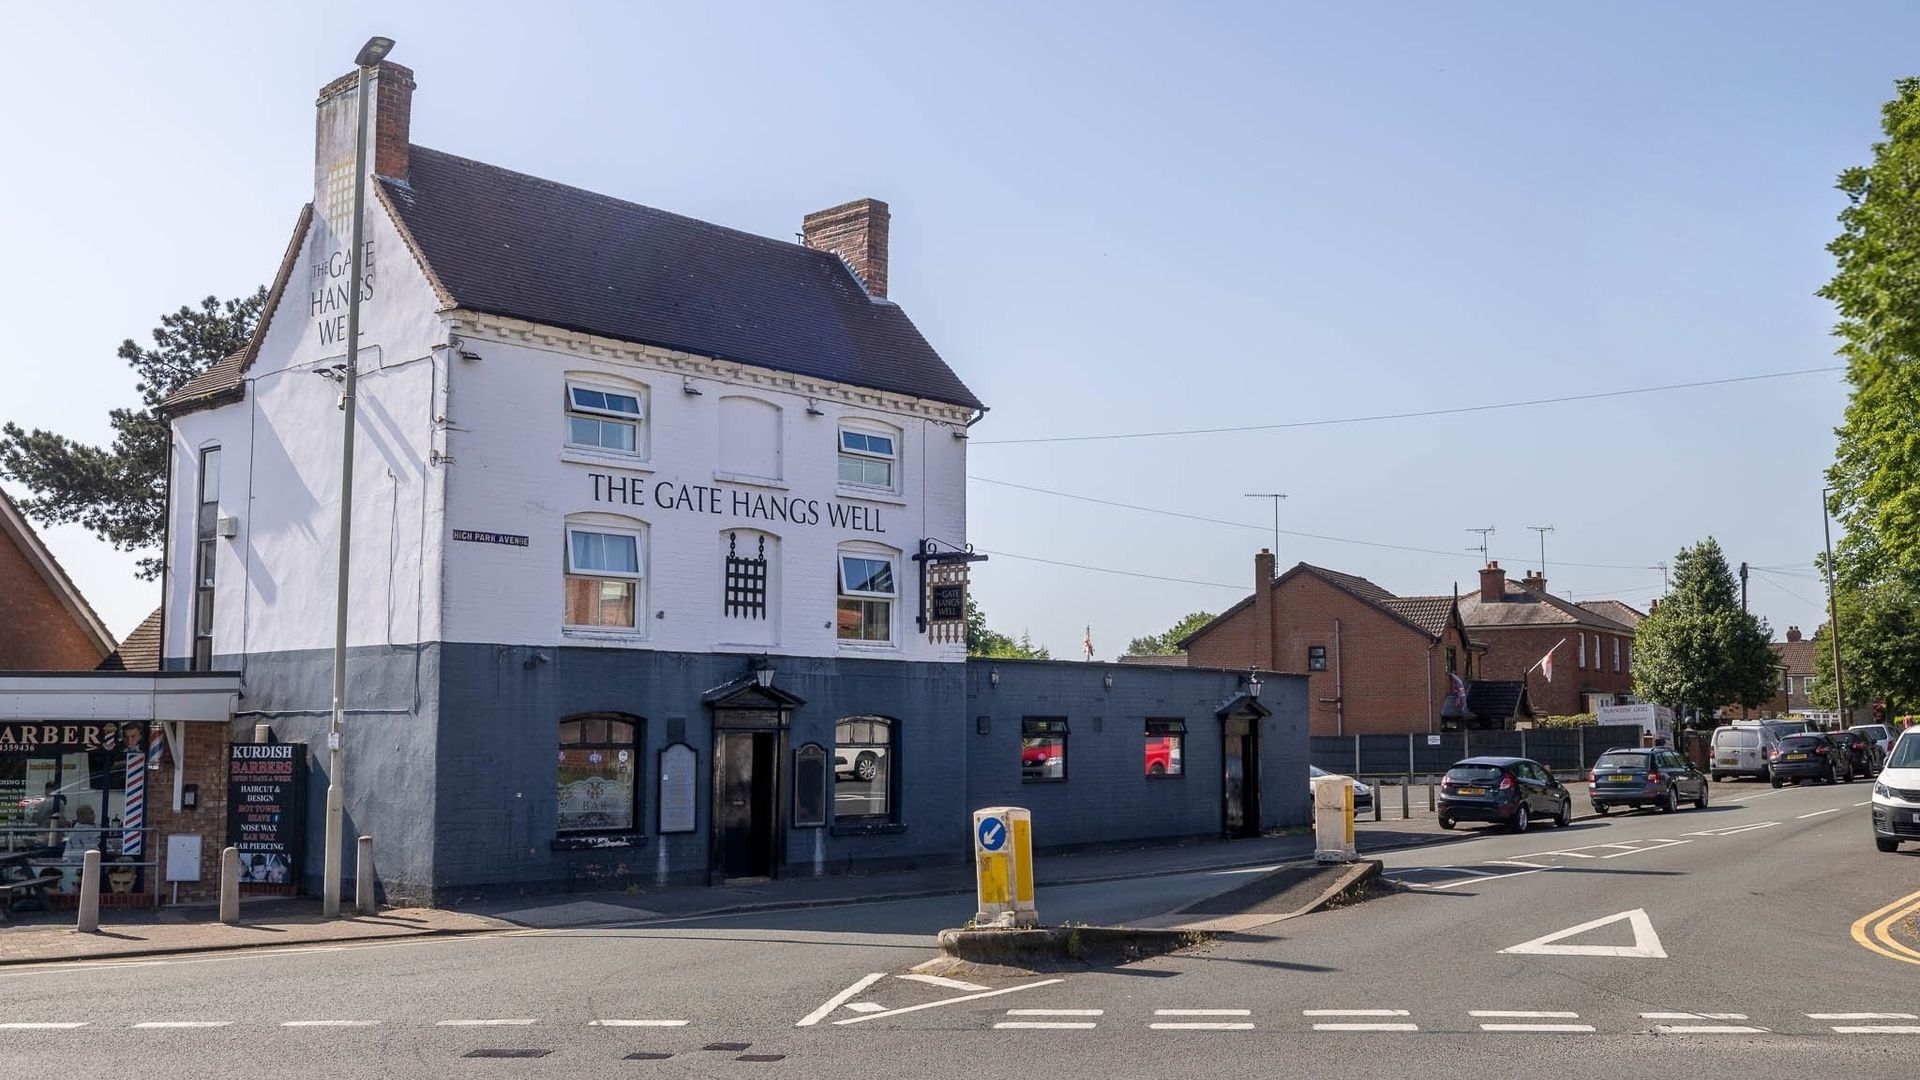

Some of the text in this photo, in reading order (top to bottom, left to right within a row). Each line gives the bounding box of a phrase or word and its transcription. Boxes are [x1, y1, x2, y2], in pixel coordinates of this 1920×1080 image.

[312, 241, 375, 278] THE GAE
[319, 314, 365, 346] WE
[588, 473, 886, 533] THE GATE HANGS WELL
[474, 533, 496, 543] PARK
[498, 535, 529, 546] AVENUE
[935, 598, 960, 608] HANGS
[938, 607, 956, 616] WELL
[232, 745, 293, 759] KURDISH
[230, 761, 293, 774] BARBERS
[240, 785, 281, 793] HAIRCUT &
[247, 794, 274, 802] DESIGN
[238, 804, 281, 813] HOT TOWEL
[247, 813, 271, 822] SHAVE
[240, 824, 277, 832] NOSE WAX
[242, 833, 275, 841] EAR WAX
[233, 842, 284, 850] EAR PIERCING
